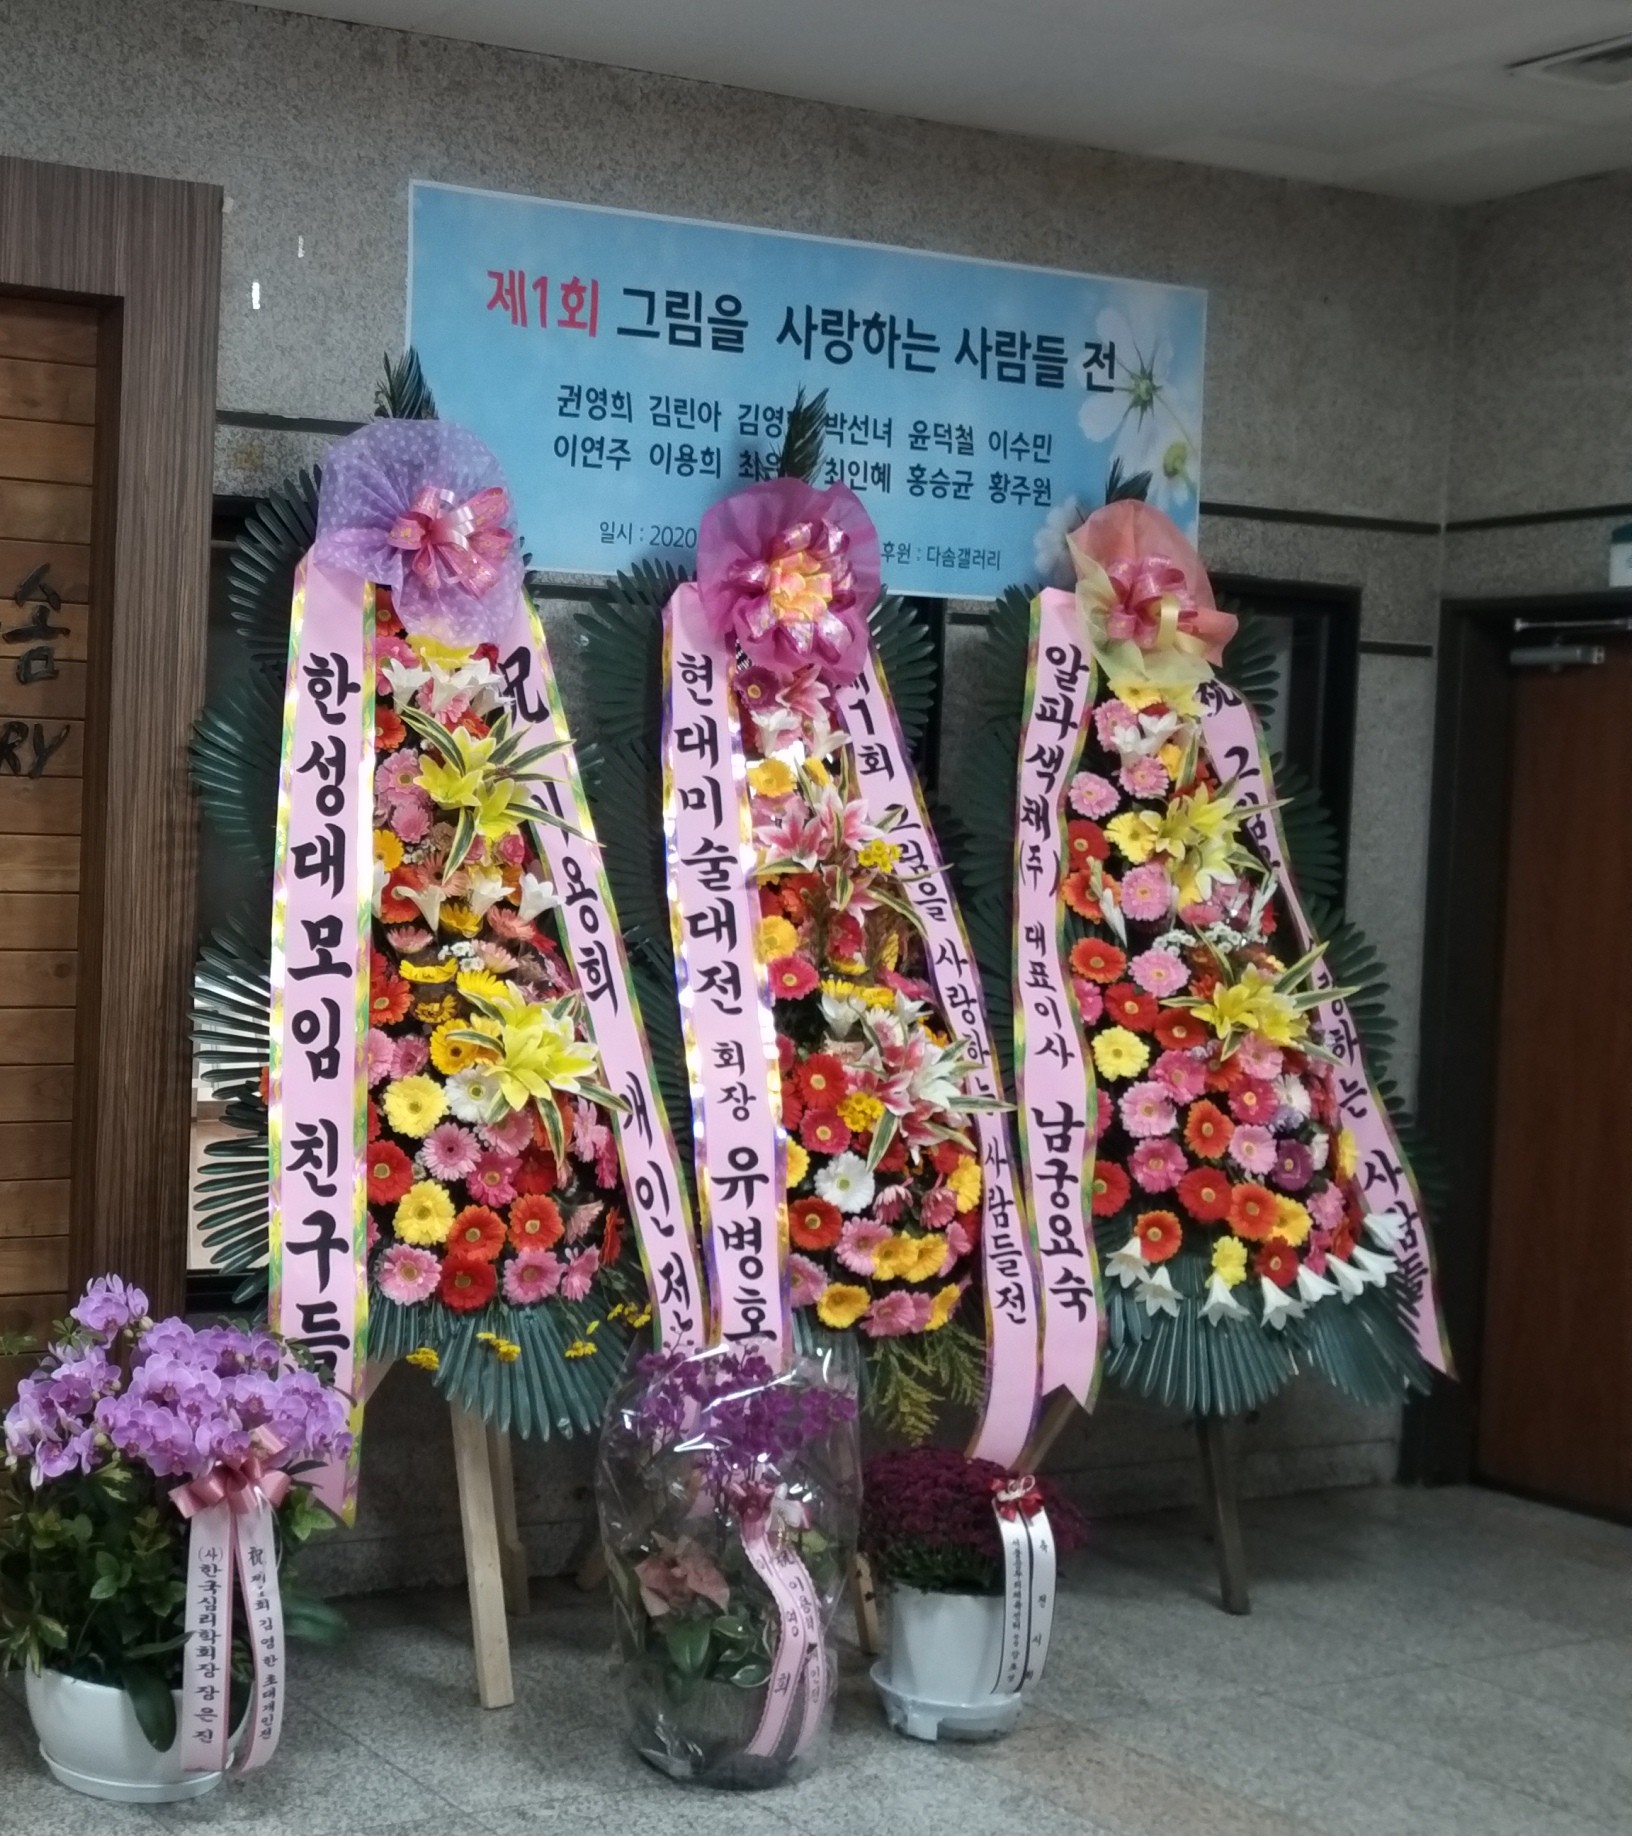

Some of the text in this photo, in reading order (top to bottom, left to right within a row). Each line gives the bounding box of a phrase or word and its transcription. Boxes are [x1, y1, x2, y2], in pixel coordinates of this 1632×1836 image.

[486, 269, 1116, 393] 제1회 그림을 사랑하는 사람들 전
[557, 384, 1052, 463] 권영희 김린아 김영 박선녀 윤덕철 이수민
[553, 434, 631, 471] 이연주
[649, 442, 721, 479] 이용희
[824, 457, 891, 493] 최인혜
[906, 463, 974, 500] 홍승균
[988, 471, 1052, 507] 황주원
[599, 520, 633, 545] 일시
[649, 524, 698, 549] 2020
[880, 540, 911, 565] 후원
[926, 545, 1001, 571] 다솜갤러리
[674, 652, 777, 1343] 현대미술대전 회장 유병호
[1024, 921, 1075, 1069] 대표이사
[1031, 1100, 1093, 1323] 남궁요숙
[248, 1546, 266, 1567] 祝
